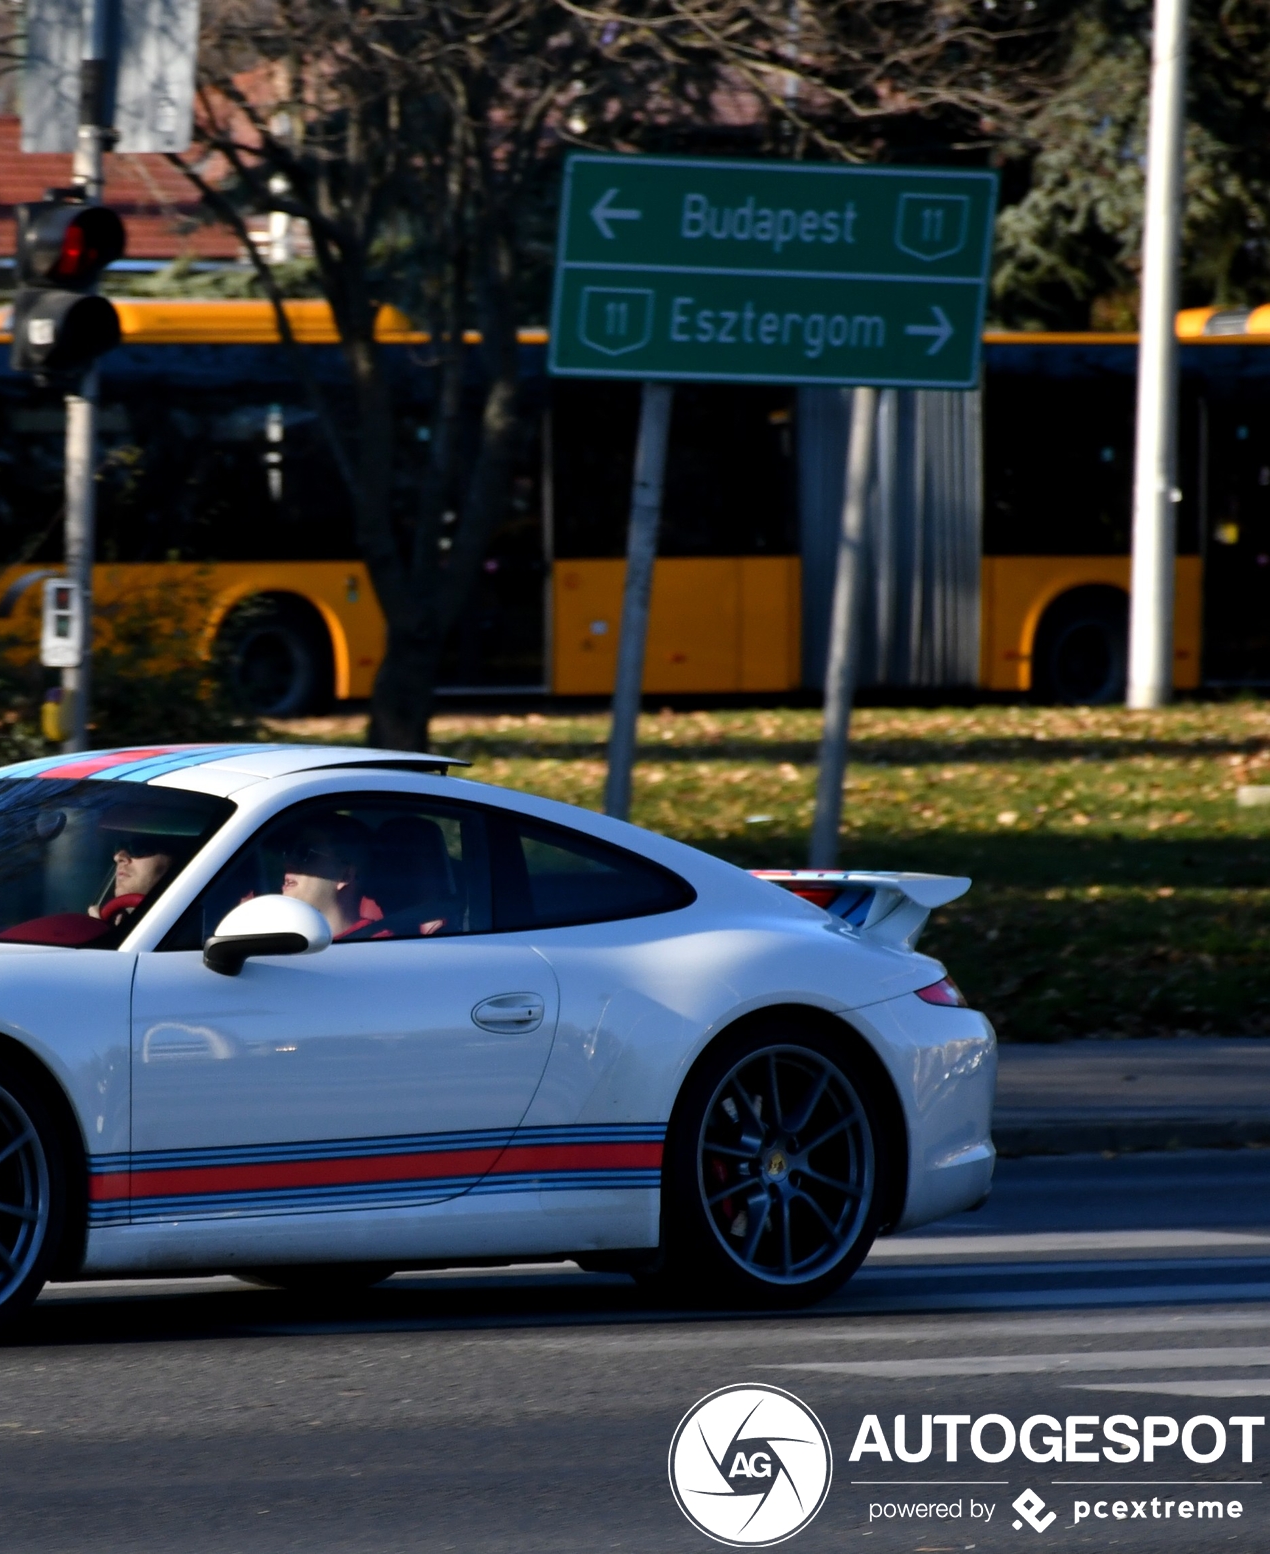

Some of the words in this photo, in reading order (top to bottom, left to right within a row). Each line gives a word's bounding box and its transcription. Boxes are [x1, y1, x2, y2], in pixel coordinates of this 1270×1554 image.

[681, 193, 858, 253] Budapest
[921, 208, 944, 242] 11
[604, 301, 630, 336] 11
[670, 297, 885, 359] Esztergom
